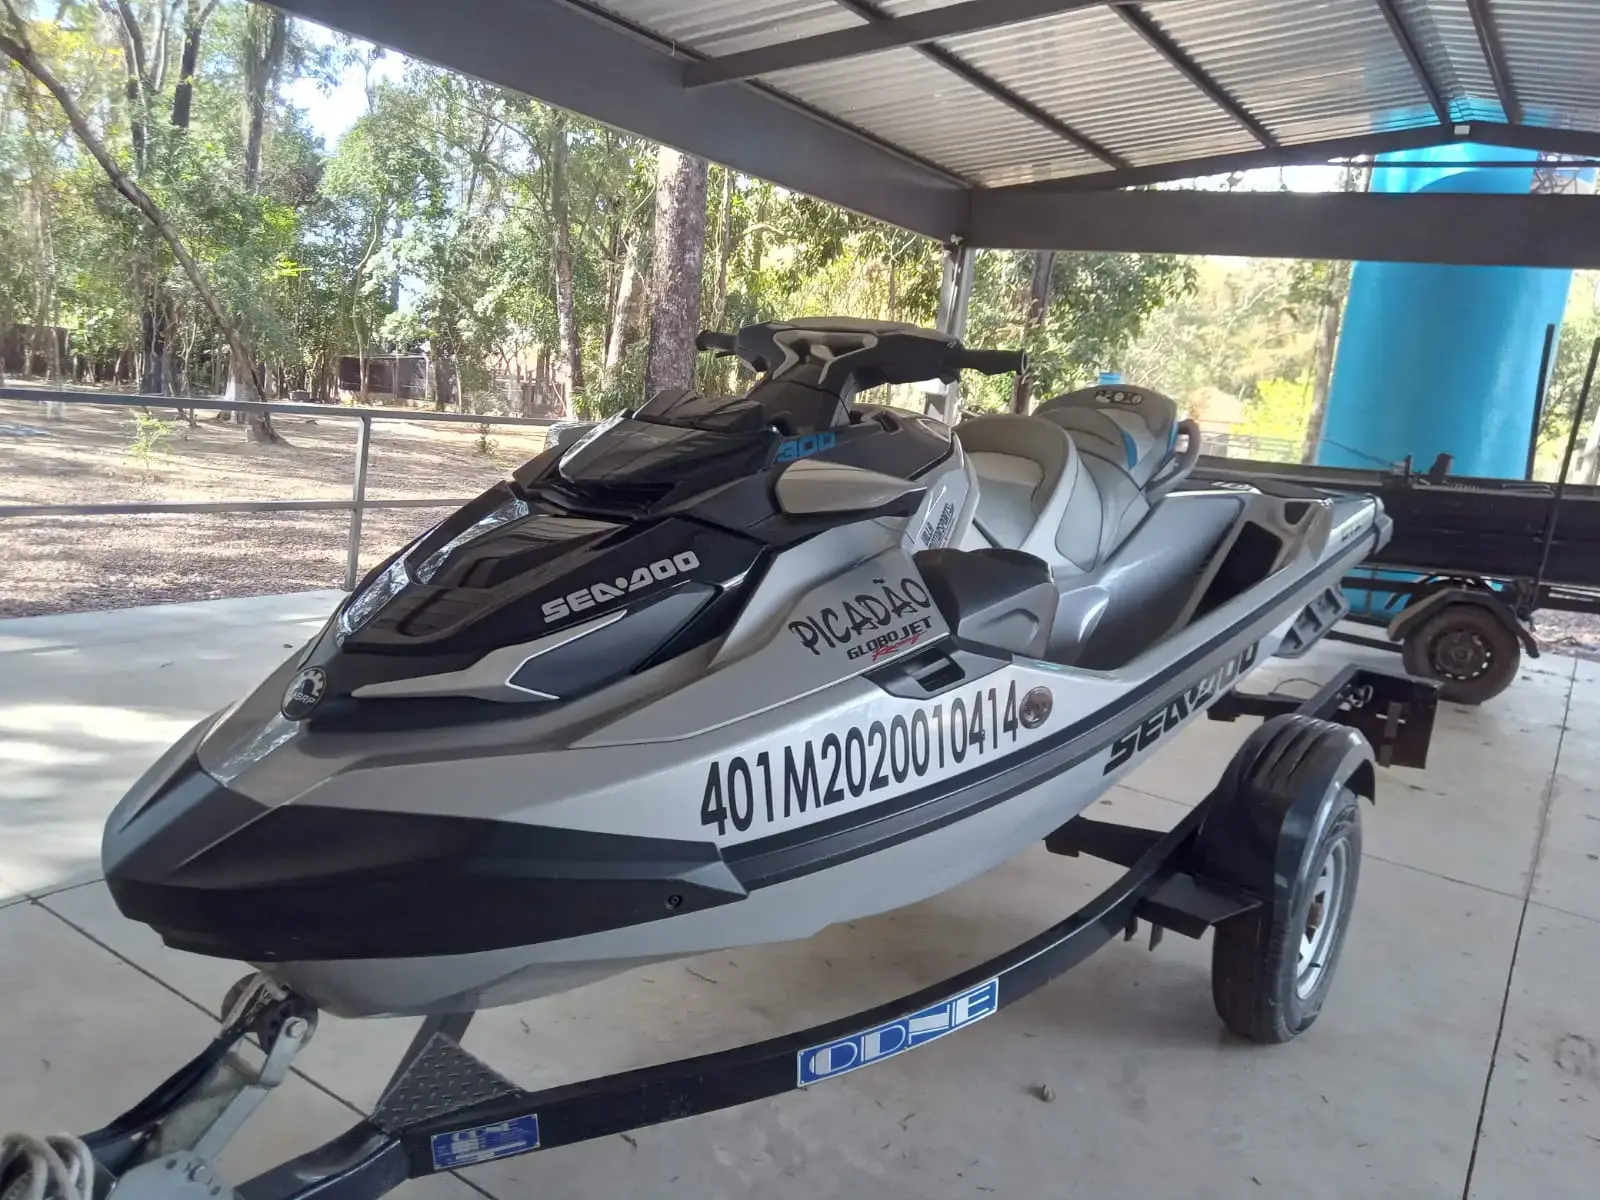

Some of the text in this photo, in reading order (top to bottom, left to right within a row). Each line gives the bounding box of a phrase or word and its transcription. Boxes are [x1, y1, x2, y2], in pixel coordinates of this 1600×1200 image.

[788, 577, 932, 655] PICADÃO
[846, 615, 932, 660] GLOBOJET
[294, 692, 316, 705] BRP
[700, 679, 1019, 837] 401M2020010414
[808, 985, 991, 1076] ODNE
